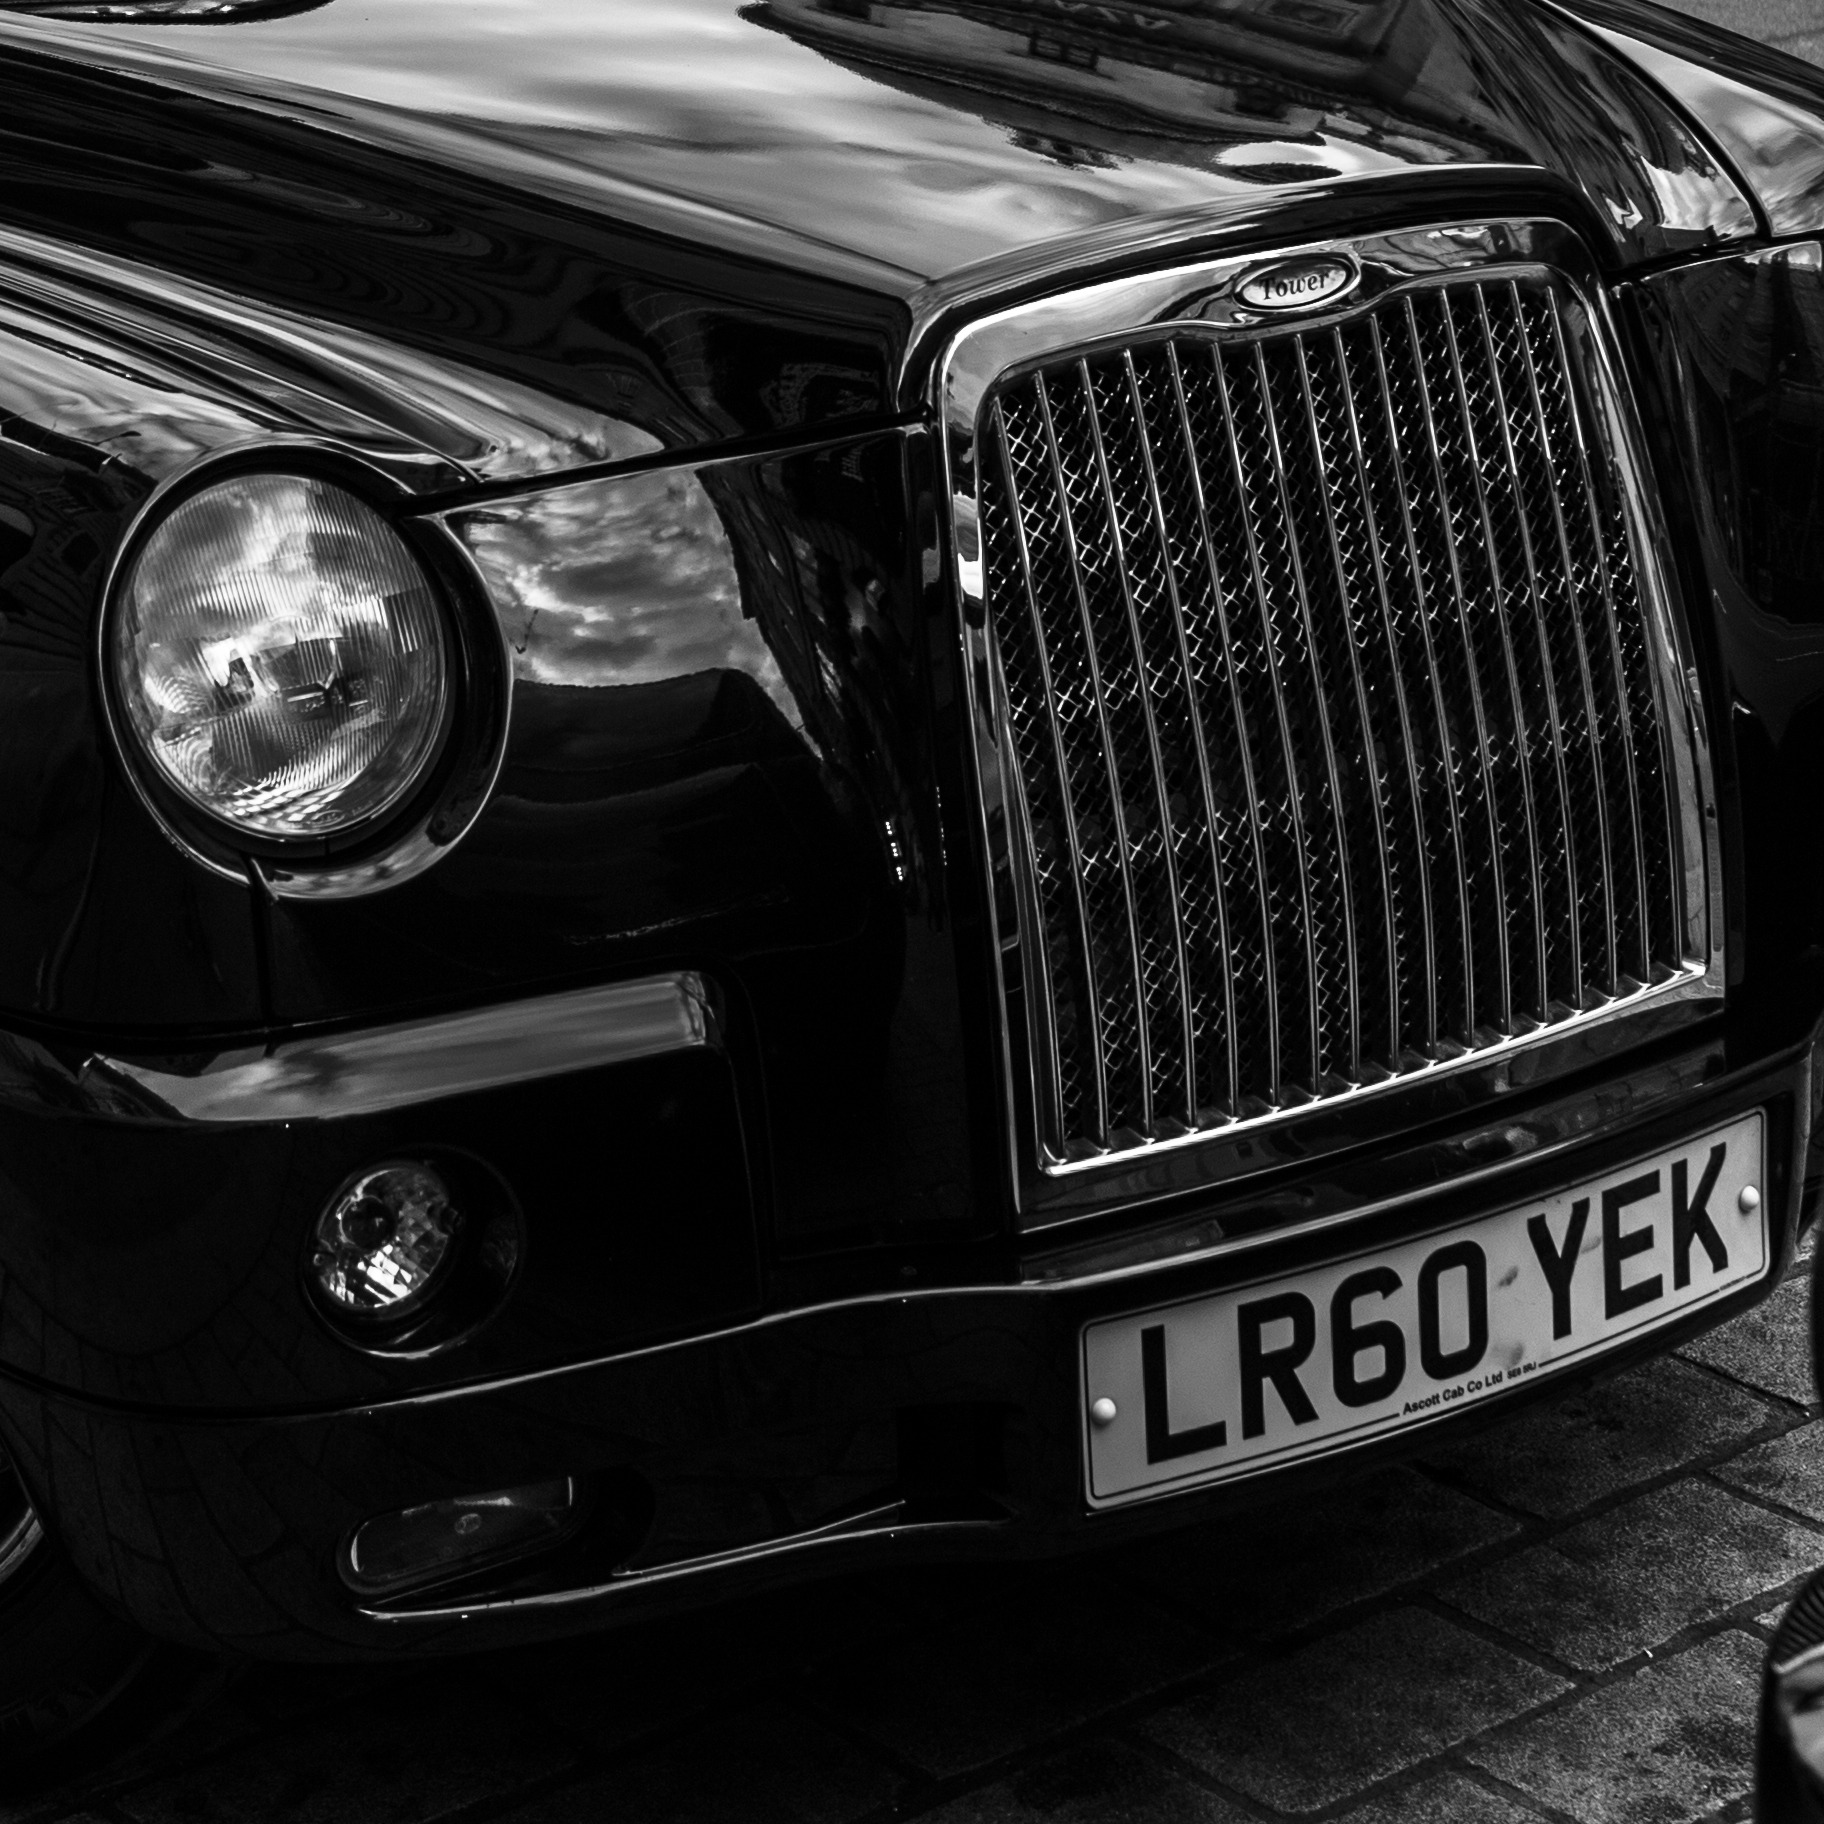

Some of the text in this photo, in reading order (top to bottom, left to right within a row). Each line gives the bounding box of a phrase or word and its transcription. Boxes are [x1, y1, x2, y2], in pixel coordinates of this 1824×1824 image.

[1259, 271, 1330, 300] Tower
[1141, 1142, 1730, 1465] LR60 YEK
[1402, 1392, 1441, 1415] Ascott
[1442, 1385, 1465, 1401] Cab
[1467, 1380, 1483, 1393] Co
[1485, 1371, 1504, 1387] Ltd
